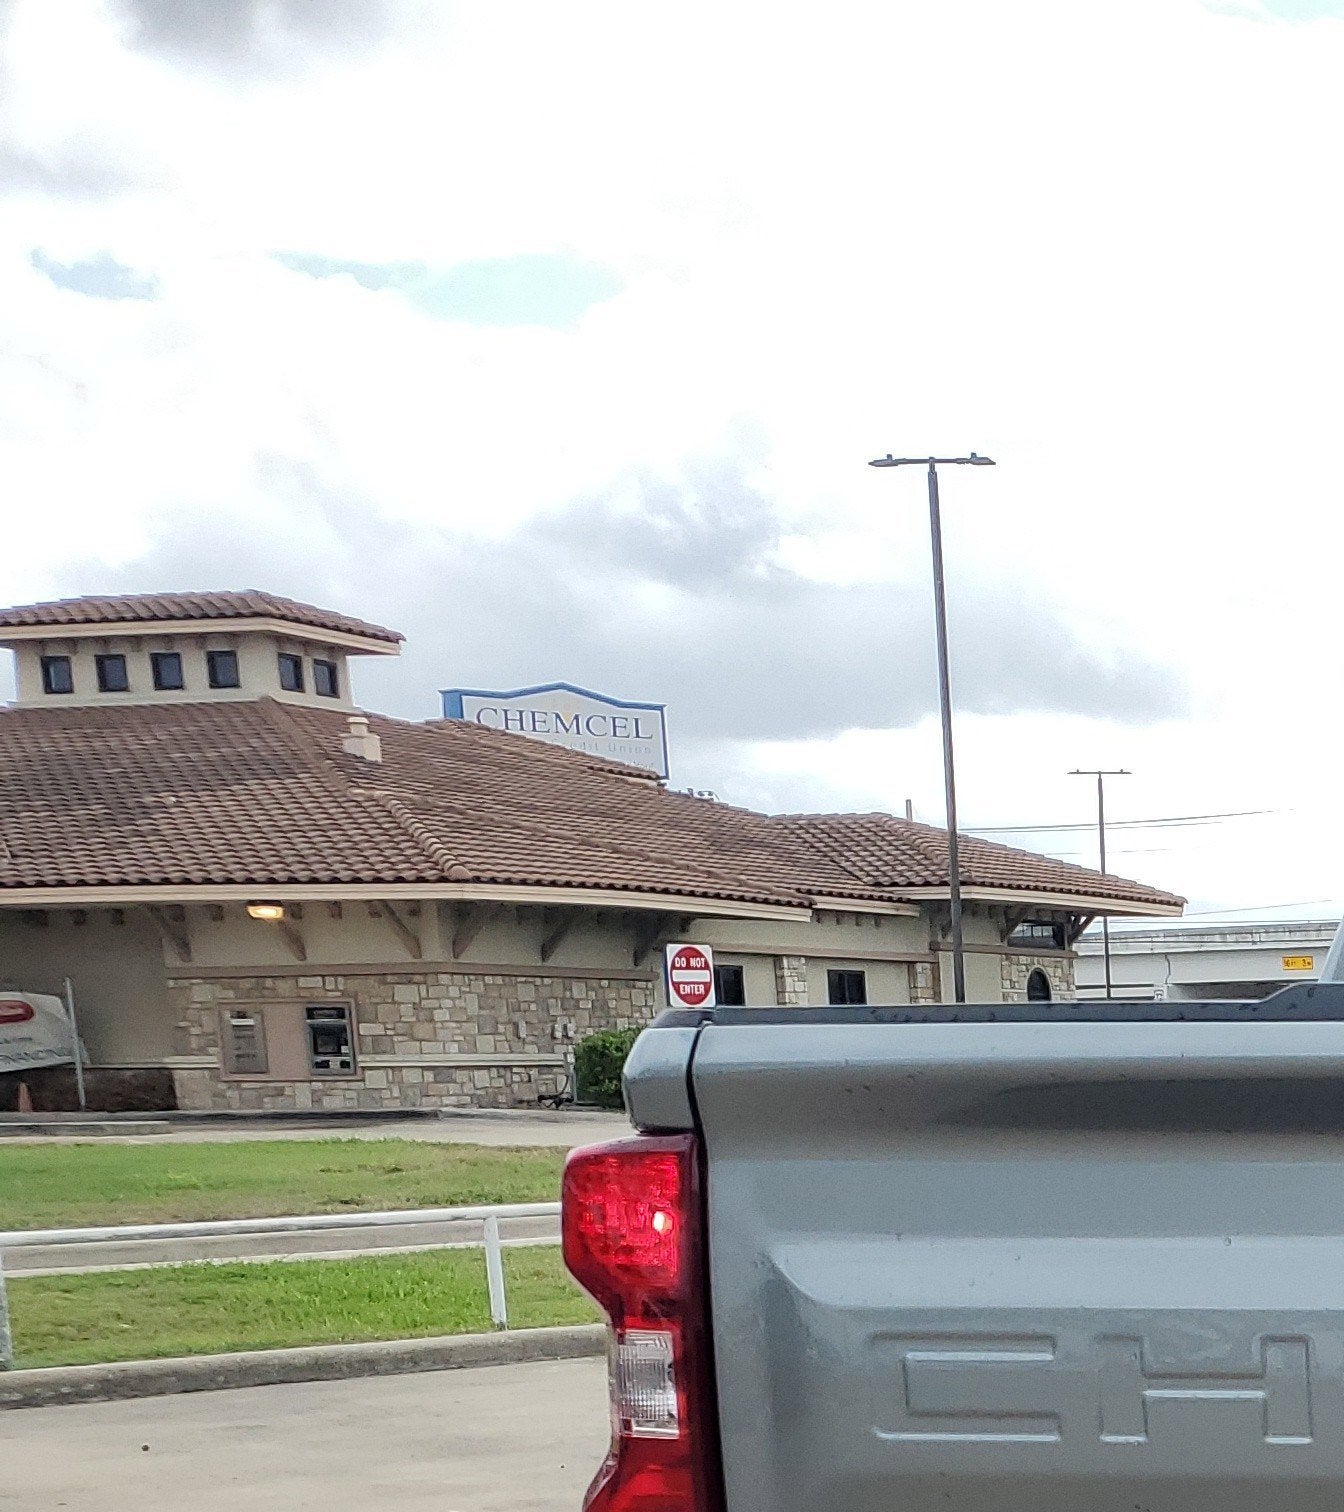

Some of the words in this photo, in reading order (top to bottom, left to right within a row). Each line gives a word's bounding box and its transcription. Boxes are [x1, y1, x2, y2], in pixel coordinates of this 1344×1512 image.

[475, 706, 653, 739] CHEMCEL
[674, 957, 687, 968] DO
[689, 957, 705, 968] NOT
[679, 984, 705, 995] ENTER
